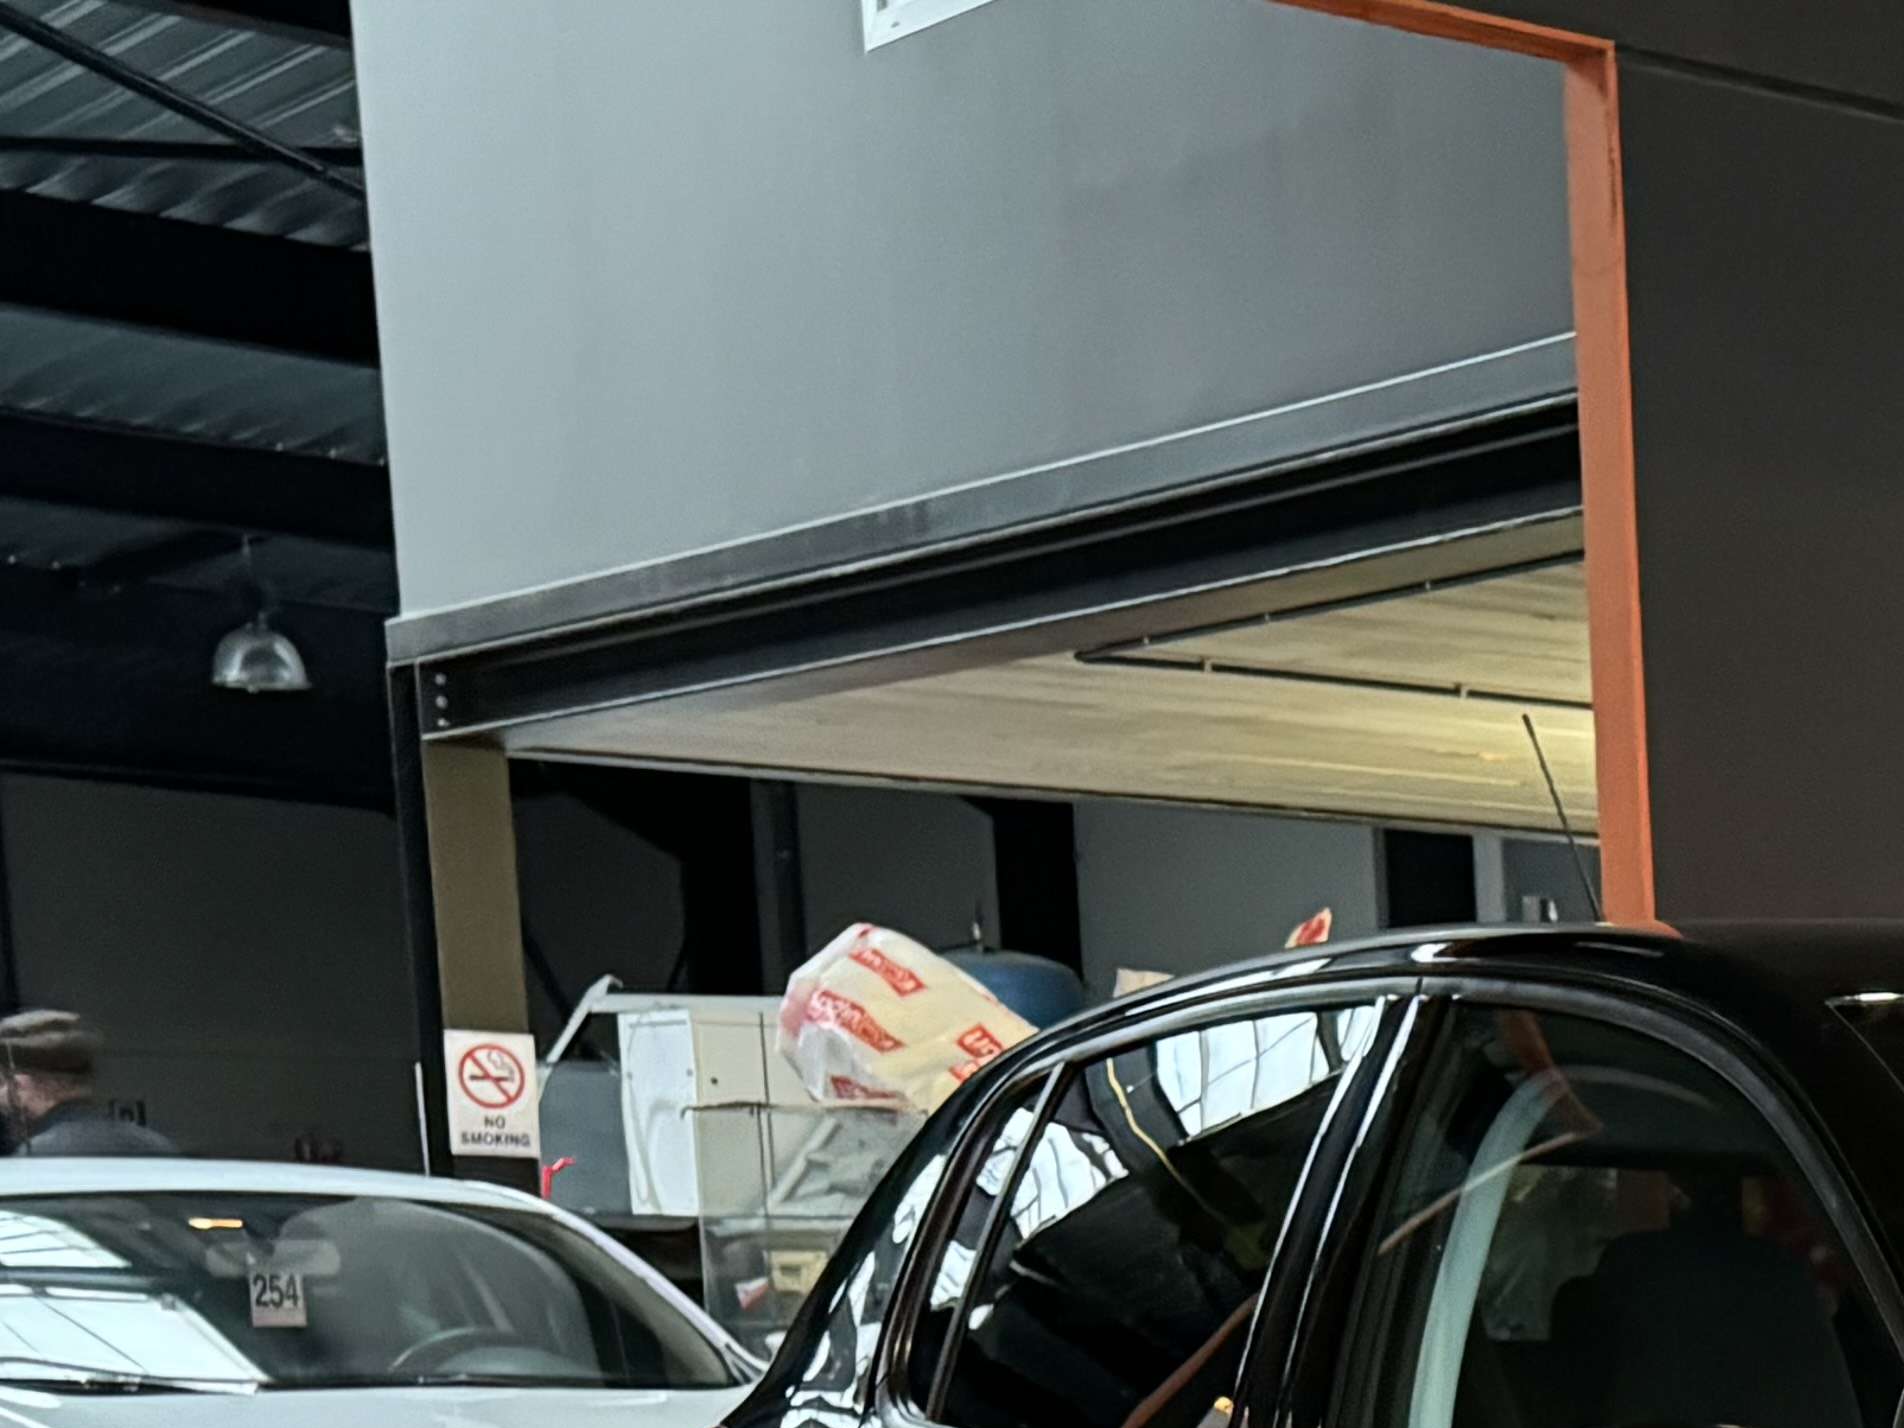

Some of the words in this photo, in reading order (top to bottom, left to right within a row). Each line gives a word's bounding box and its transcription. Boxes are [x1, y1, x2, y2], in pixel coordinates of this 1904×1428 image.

[483, 1115, 505, 1129] NO
[460, 1129, 531, 1147] SMOKING
[253, 1273, 299, 1308] 254
